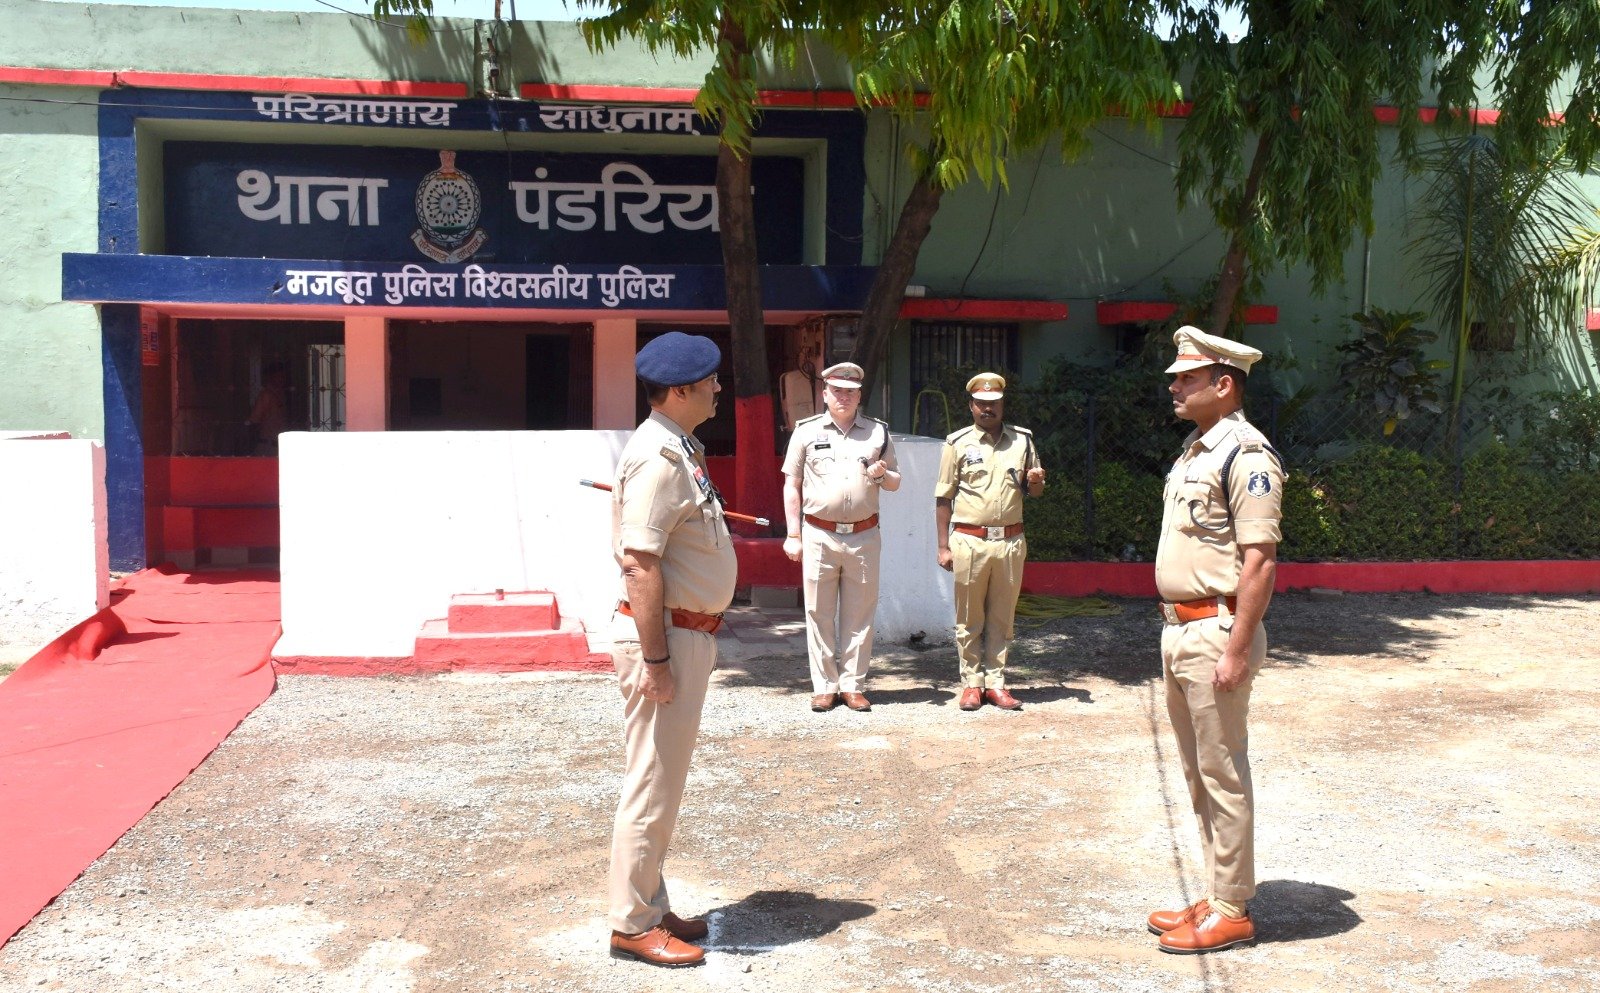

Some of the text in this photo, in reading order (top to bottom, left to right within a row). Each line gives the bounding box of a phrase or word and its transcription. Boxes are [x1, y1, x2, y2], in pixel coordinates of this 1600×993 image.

[252, 93, 458, 127] परित्राणाय
[236, 161, 755, 234] थाना पंडरिय
[286, 264, 675, 307] मजबूत पुलिस विश्वसनीय पुलिस
